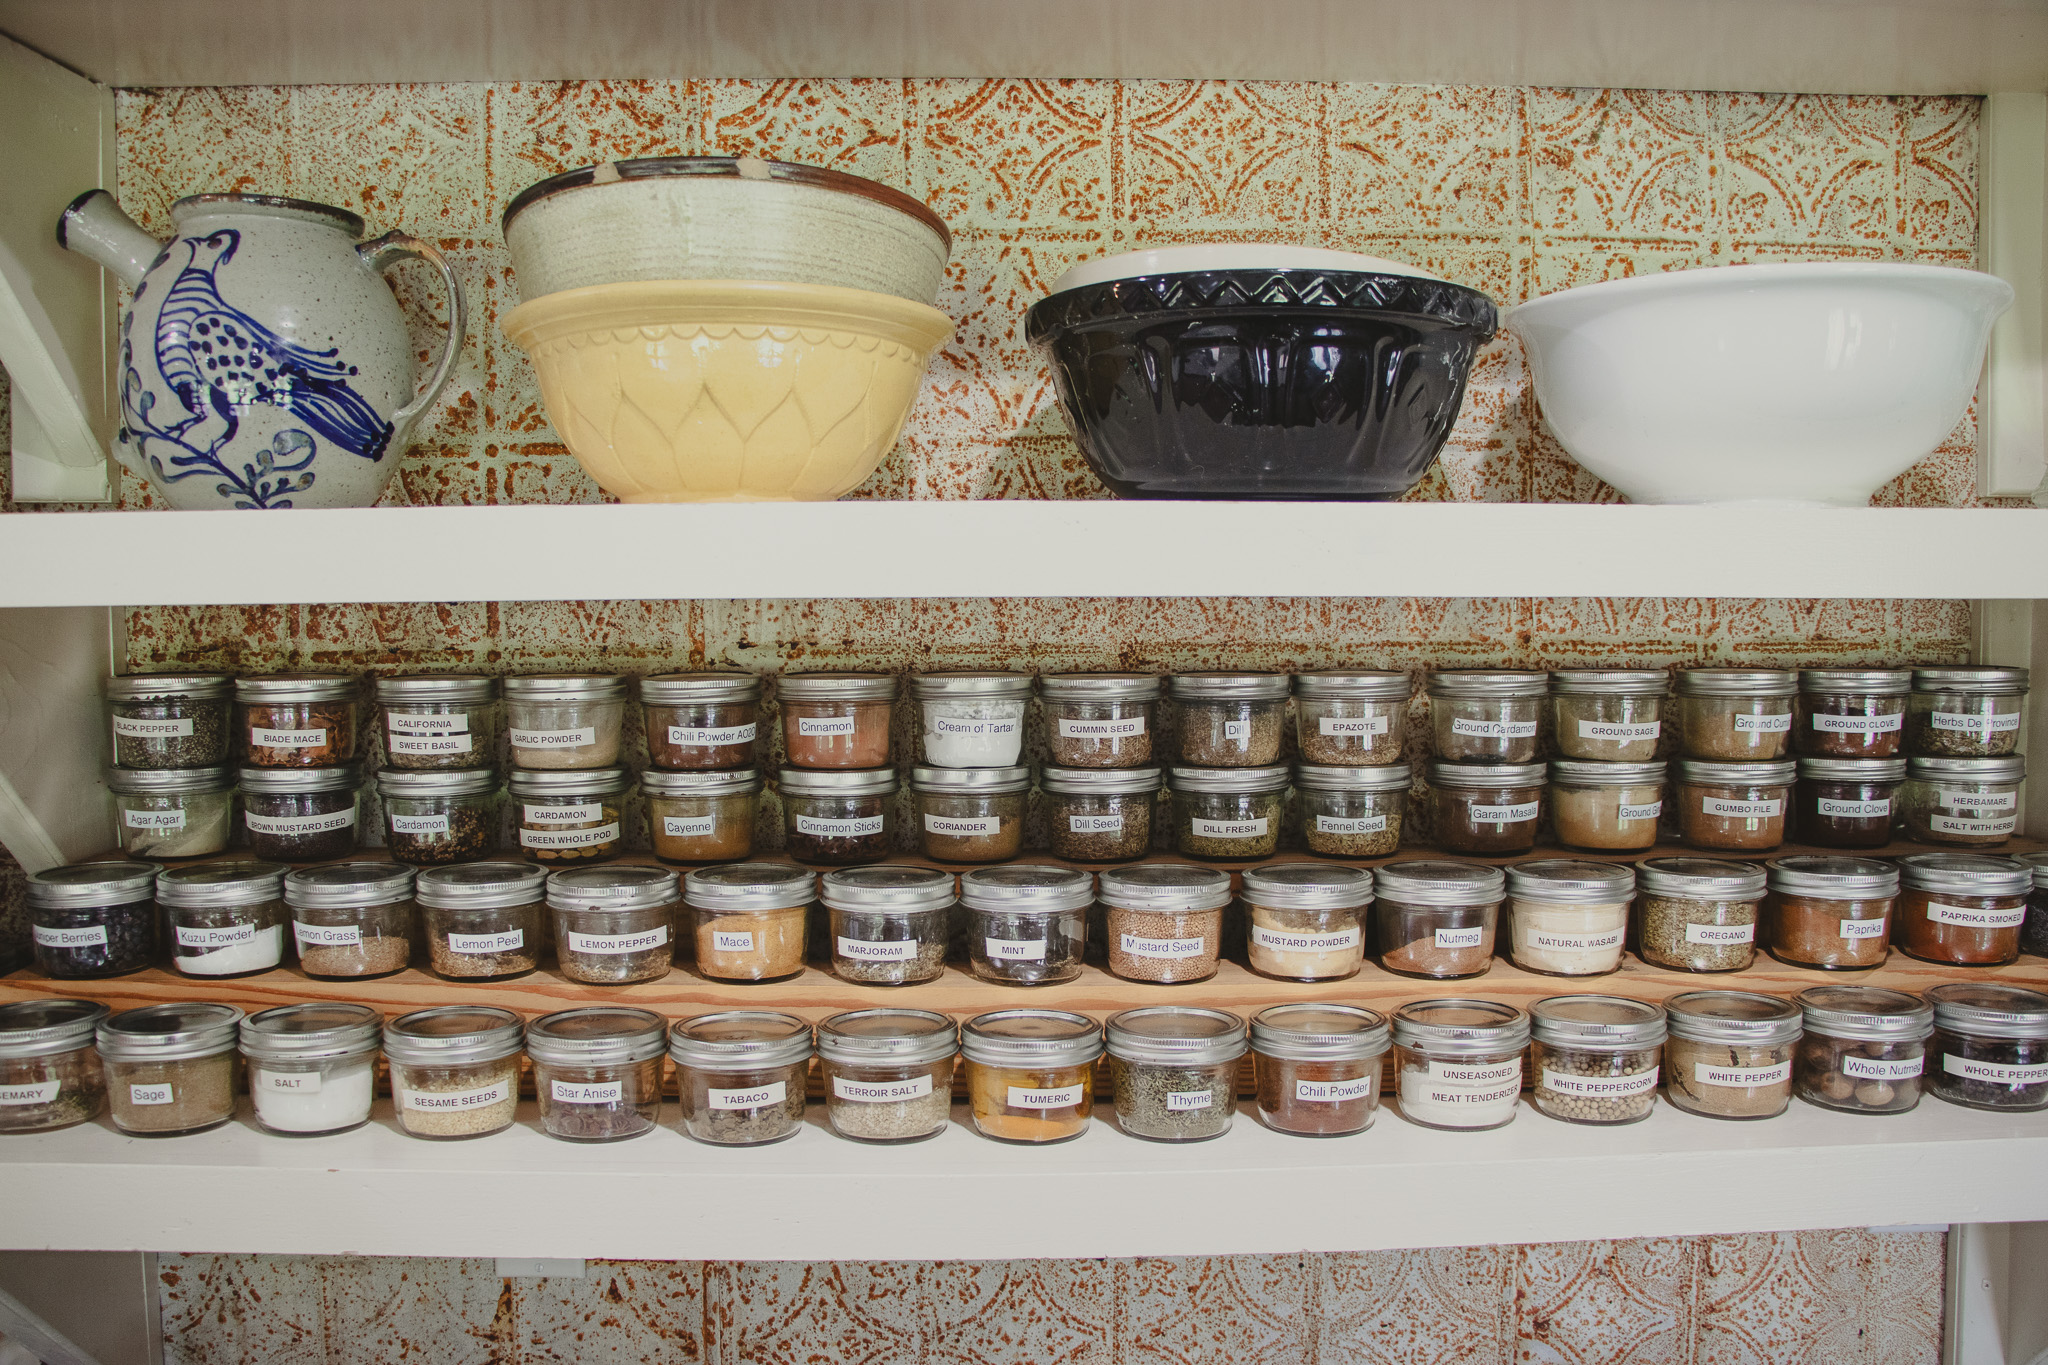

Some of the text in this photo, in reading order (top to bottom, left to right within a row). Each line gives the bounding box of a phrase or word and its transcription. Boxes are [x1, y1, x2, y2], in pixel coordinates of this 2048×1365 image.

[117, 721, 179, 733] BLACK PEPPER
[397, 720, 452, 728] CALIFORNIA
[801, 721, 852, 732] Cinnamon
[938, 721, 1014, 733] Cream of Tartar
[1332, 722, 1376, 731] EPAZOTE
[1453, 719, 1489, 733] Ground
[1736, 717, 1772, 729] Ground
[1824, 719, 1895, 729] GROUND CLOVE
[1933, 715, 1964, 728] Herbs
[1967, 718, 1982, 728] De
[1069, 724, 1135, 734] CUMMIN SEED
[1228, 725, 1245, 735] Dill
[1591, 727, 1654, 736] GROUND SAGE
[294, 734, 322, 743] MACE
[514, 734, 582, 744] GARLIC POWDER
[672, 730, 695, 741] Chili
[698, 730, 735, 742] Powder
[399, 741, 459, 750] SWEET BASIL
[1953, 797, 2008, 806] HERBAMARE
[1473, 805, 1537, 819] Garam Masala
[1620, 807, 1651, 818] Ground
[1715, 804, 1771, 813] GUMBO FILE
[1823, 802, 1887, 814] Ground Clove
[131, 813, 180, 825] Agar Agar
[534, 811, 587, 819] CARDAMON
[251, 817, 346, 832] BROWN MUSTARD SEED
[396, 818, 445, 830] Cardamon
[667, 821, 711, 834] Cayenne
[801, 820, 881, 832] Cinnamon Sticks
[933, 821, 987, 831] CORIANDER
[1074, 817, 1120, 829] Dill Seed
[1203, 825, 1257, 833] DILL FRESH
[1321, 819, 1383, 831] Fennel Seed
[1943, 821, 2013, 831] SALT WITH HERBS
[527, 830, 611, 844] GREEN WHOLE POD
[1941, 911, 2021, 923] PAPRIKA SMOKED
[296, 925, 356, 941] Lemon Grass
[1846, 923, 1881, 935] Paprika
[61, 931, 101, 943] Berries
[181, 930, 252, 943] Kuzu Powder
[455, 934, 520, 949] Lemon Peel
[720, 936, 750, 947] Mace
[1261, 934, 1350, 947] MUSTARD POWDER
[1439, 933, 1479, 946] Nutmeg
[1538, 935, 1618, 947] NATURAL WASABI
[1700, 931, 1746, 940] OREGANO
[580, 935, 657, 949] LEMON PEPPER
[1126, 938, 1199, 953] Mustard Seed
[847, 945, 903, 956] MARJORAM
[1001, 946, 1025, 955] MINT
[1443, 1067, 1512, 1079] UNSEASONED
[1848, 1061, 1921, 1075] Whole Nutmeg
[1964, 1065, 2004, 1078] WHOLE
[1708, 1069, 1782, 1082] WHITE PEPPER
[275, 1079, 301, 1088] SALT
[1300, 1083, 1368, 1096] Chili Powder
[1553, 1076, 1652, 1092] WHITE PEPPERCORN
[0, 1090, 44, 1100] EMARY
[134, 1089, 165, 1101] Sage
[557, 1086, 617, 1098] Star Anise
[843, 1085, 918, 1097] TERROIR SALT
[1432, 1084, 1518, 1103] MEAT TENDERIZER
[415, 1090, 497, 1107] SESAME SEEDS
[723, 1092, 769, 1104] TABACO
[1023, 1094, 1070, 1103] TUMERIC
[1171, 1093, 1211, 1107] Thyme
